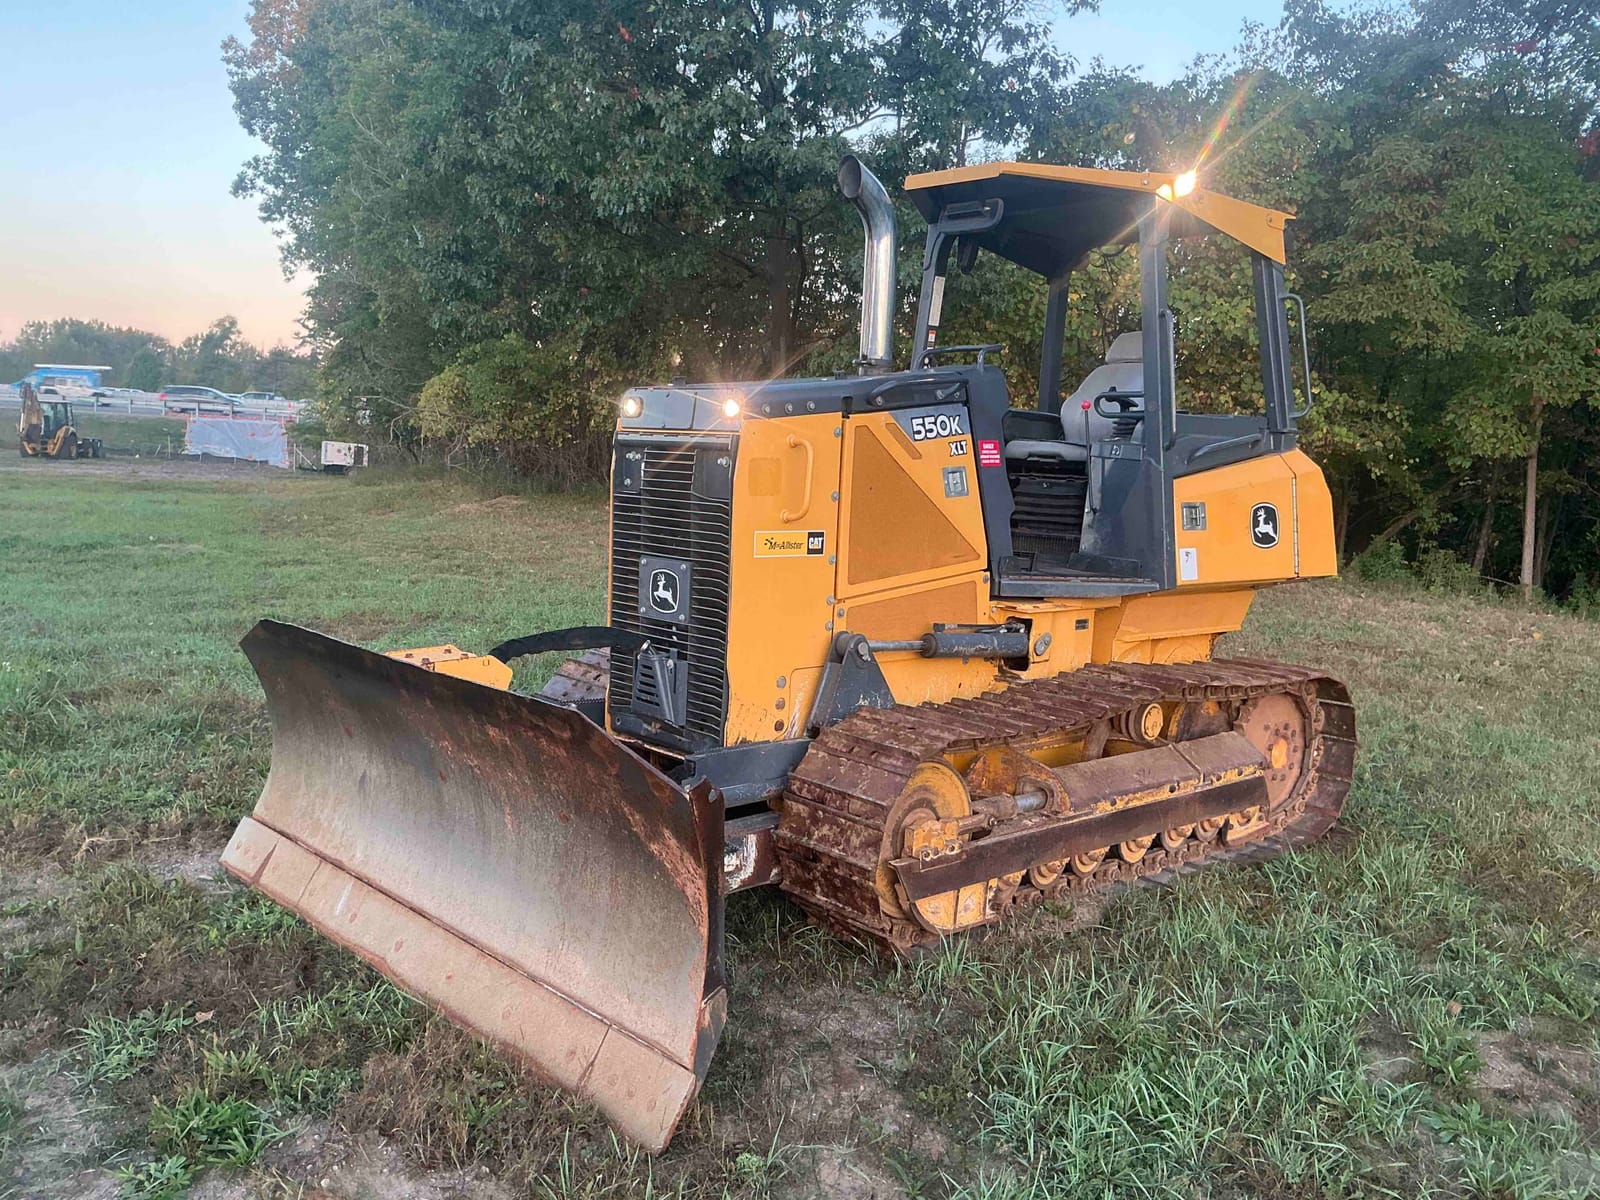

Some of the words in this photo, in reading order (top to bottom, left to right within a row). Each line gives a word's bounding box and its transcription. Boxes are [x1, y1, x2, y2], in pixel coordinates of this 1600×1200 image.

[911, 414, 963, 441] 550K
[949, 440, 967, 457] XLT
[808, 537, 824, 549] CAT
